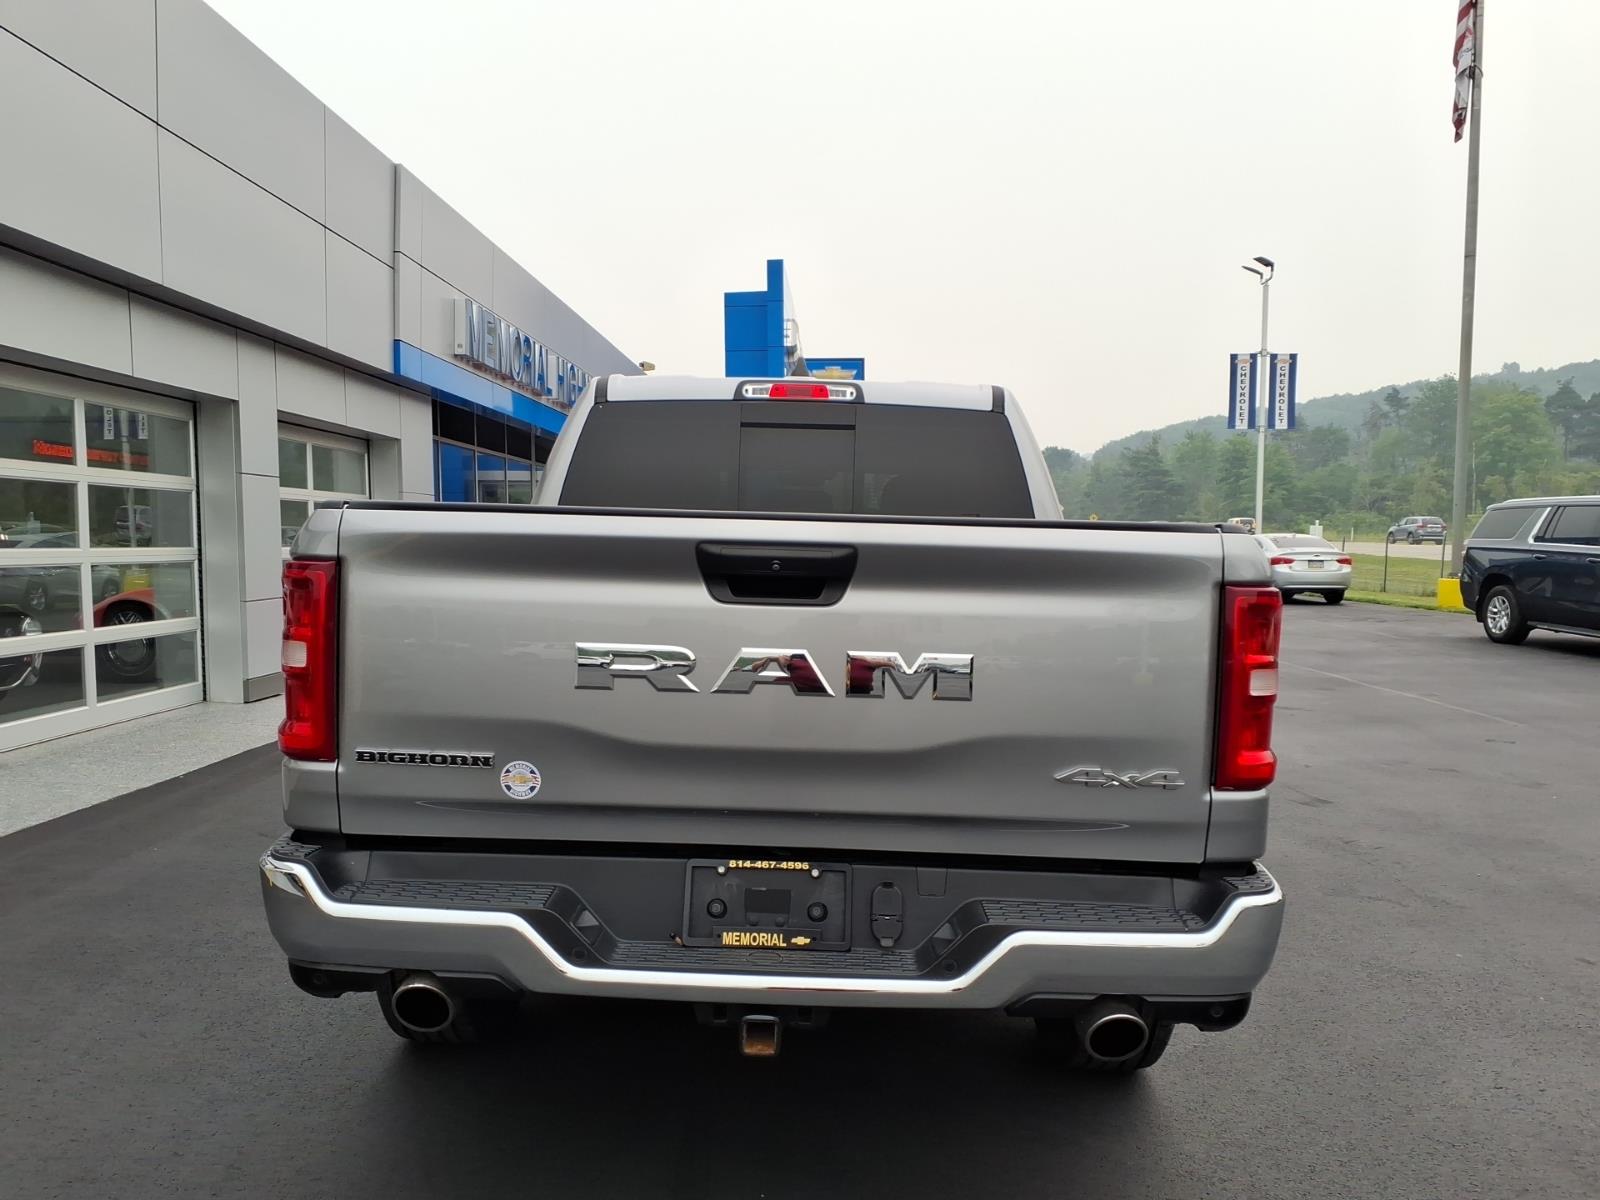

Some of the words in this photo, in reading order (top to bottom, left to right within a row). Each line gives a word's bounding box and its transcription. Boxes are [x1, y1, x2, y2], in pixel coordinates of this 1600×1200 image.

[460, 299, 553, 398] MEMORIAL
[1239, 365, 1248, 424] CHEVROLET
[1278, 365, 1287, 424] CHEVROLET
[574, 641, 974, 702] RAM
[355, 750, 495, 768] BIGHORN
[728, 859, 810, 871] 814-467-4596
[722, 931, 788, 948] MEMORIAL
